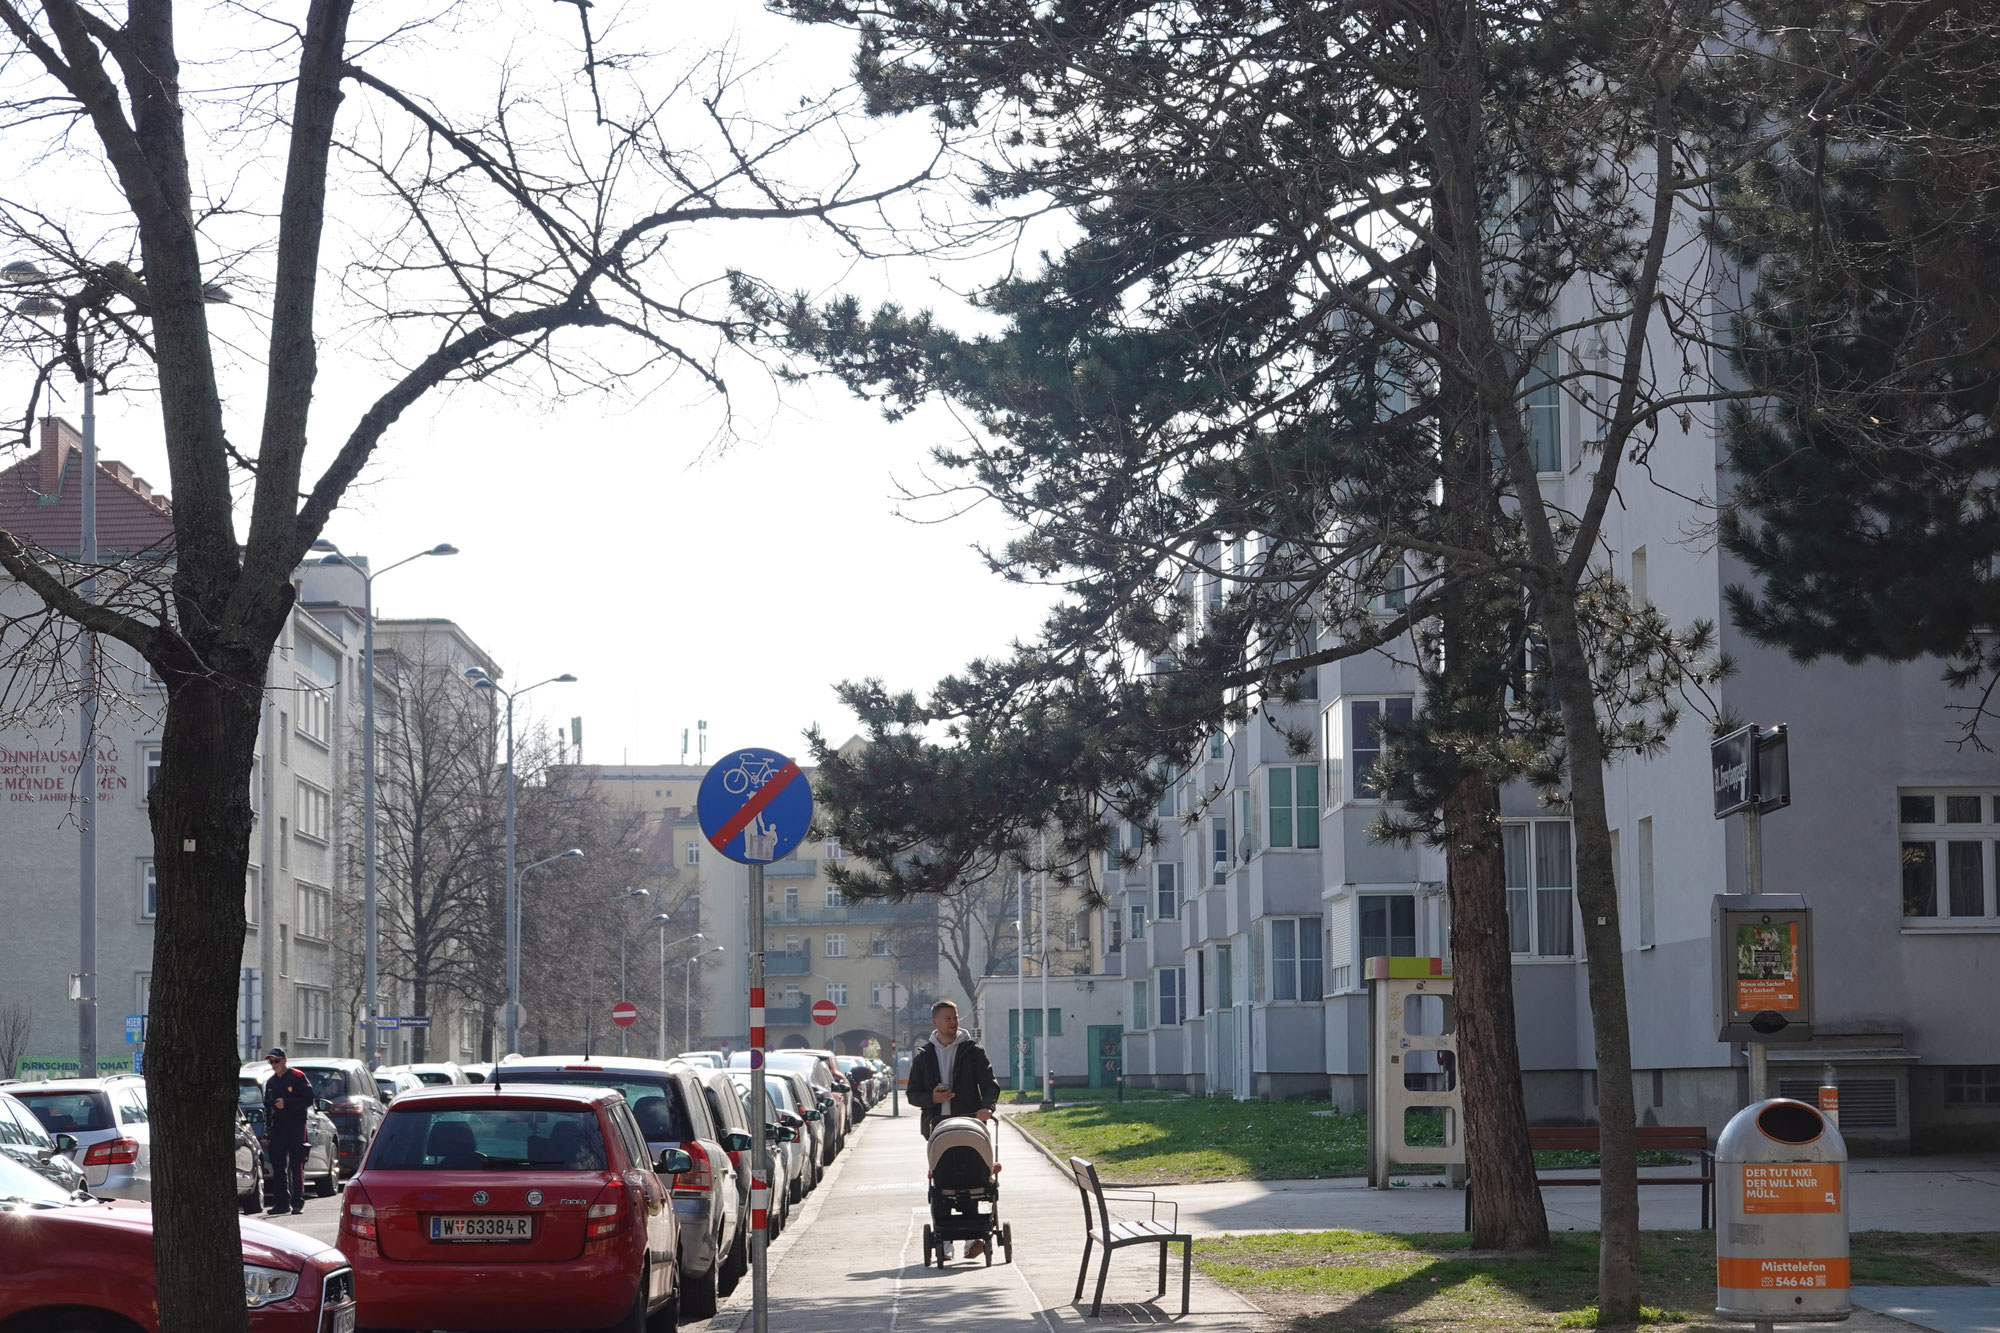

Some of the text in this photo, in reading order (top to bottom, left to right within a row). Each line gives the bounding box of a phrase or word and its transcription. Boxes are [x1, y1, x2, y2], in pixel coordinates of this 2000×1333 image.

[1746, 1168, 1812, 1177] DER TUT NIX!
[1746, 1179, 1818, 1188] DER WILL NUR
[1746, 1187, 1779, 1198] MÜLL.
[443, 1219, 455, 1235] W
[1761, 1261, 1826, 1272] Misttelefon
[1775, 1276, 1814, 1287] 546 48
